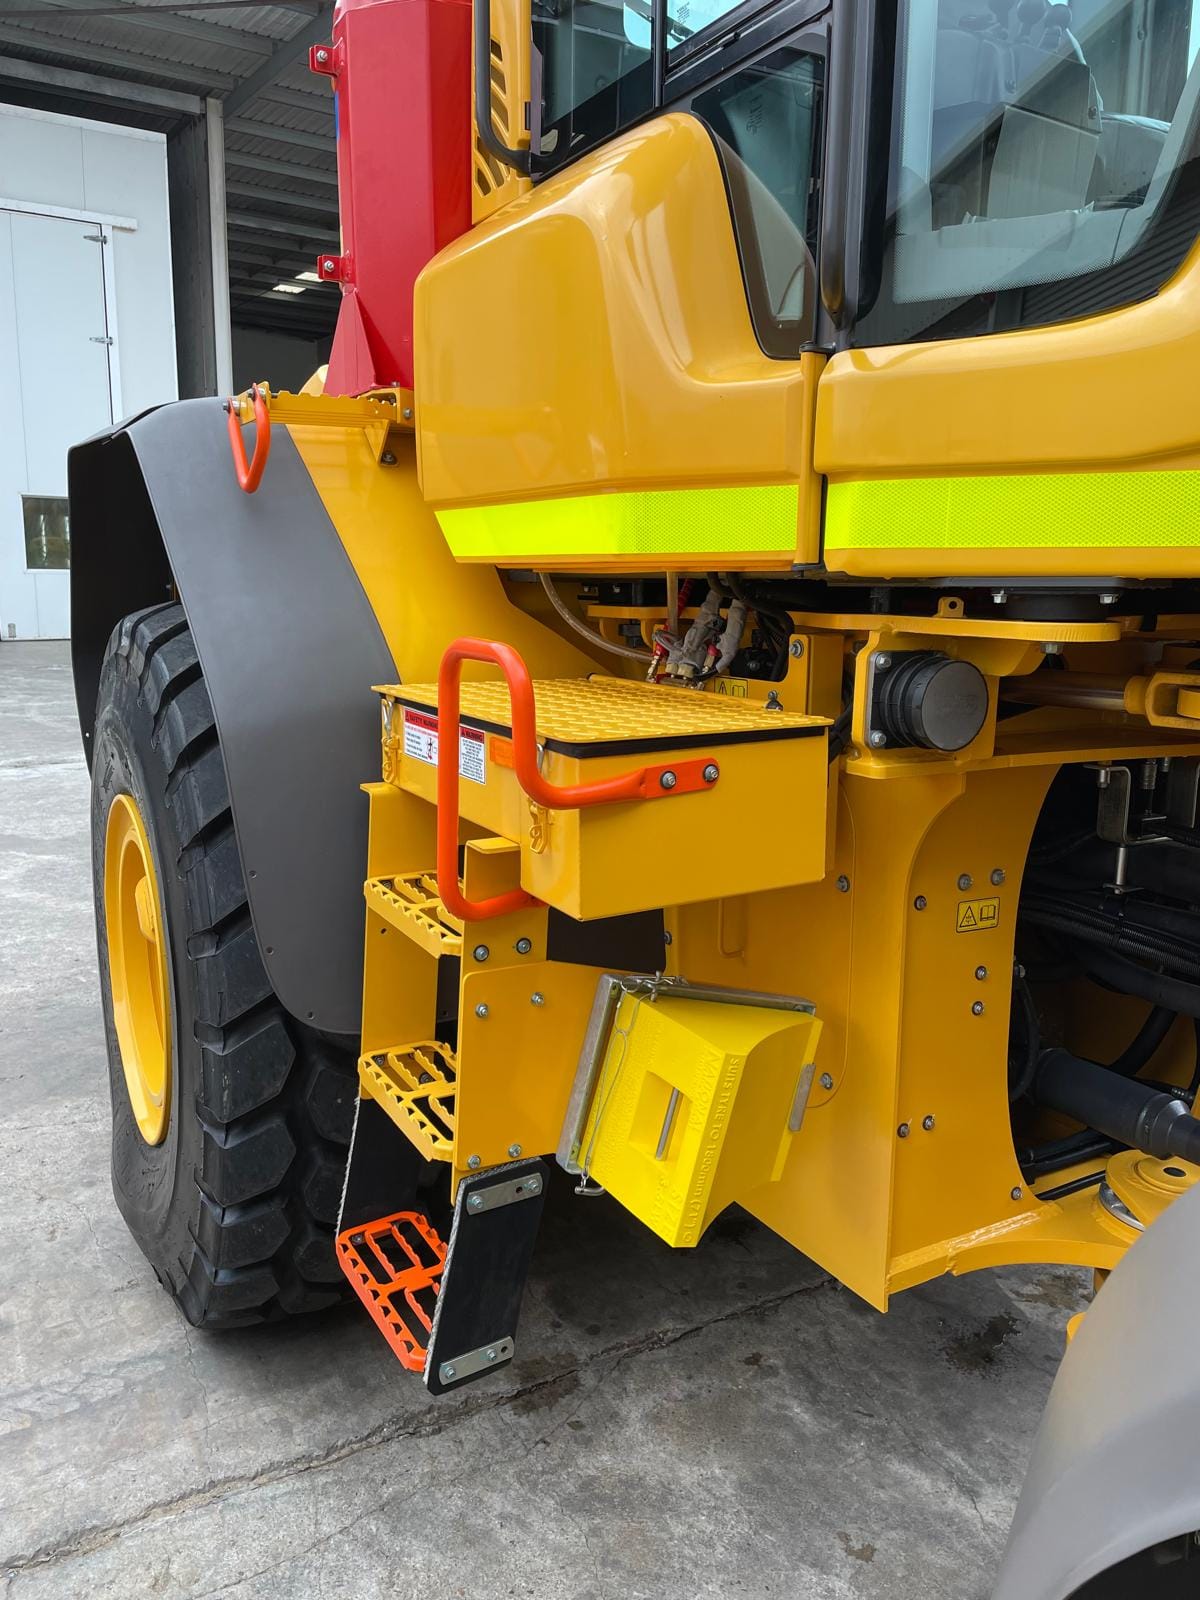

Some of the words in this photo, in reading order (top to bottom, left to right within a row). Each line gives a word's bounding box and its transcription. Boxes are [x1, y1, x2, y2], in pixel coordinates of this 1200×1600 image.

[723, 1057, 740, 1089] SUITS
[714, 1091, 731, 1122] TYRE
[710, 1123, 722, 1140] TO
